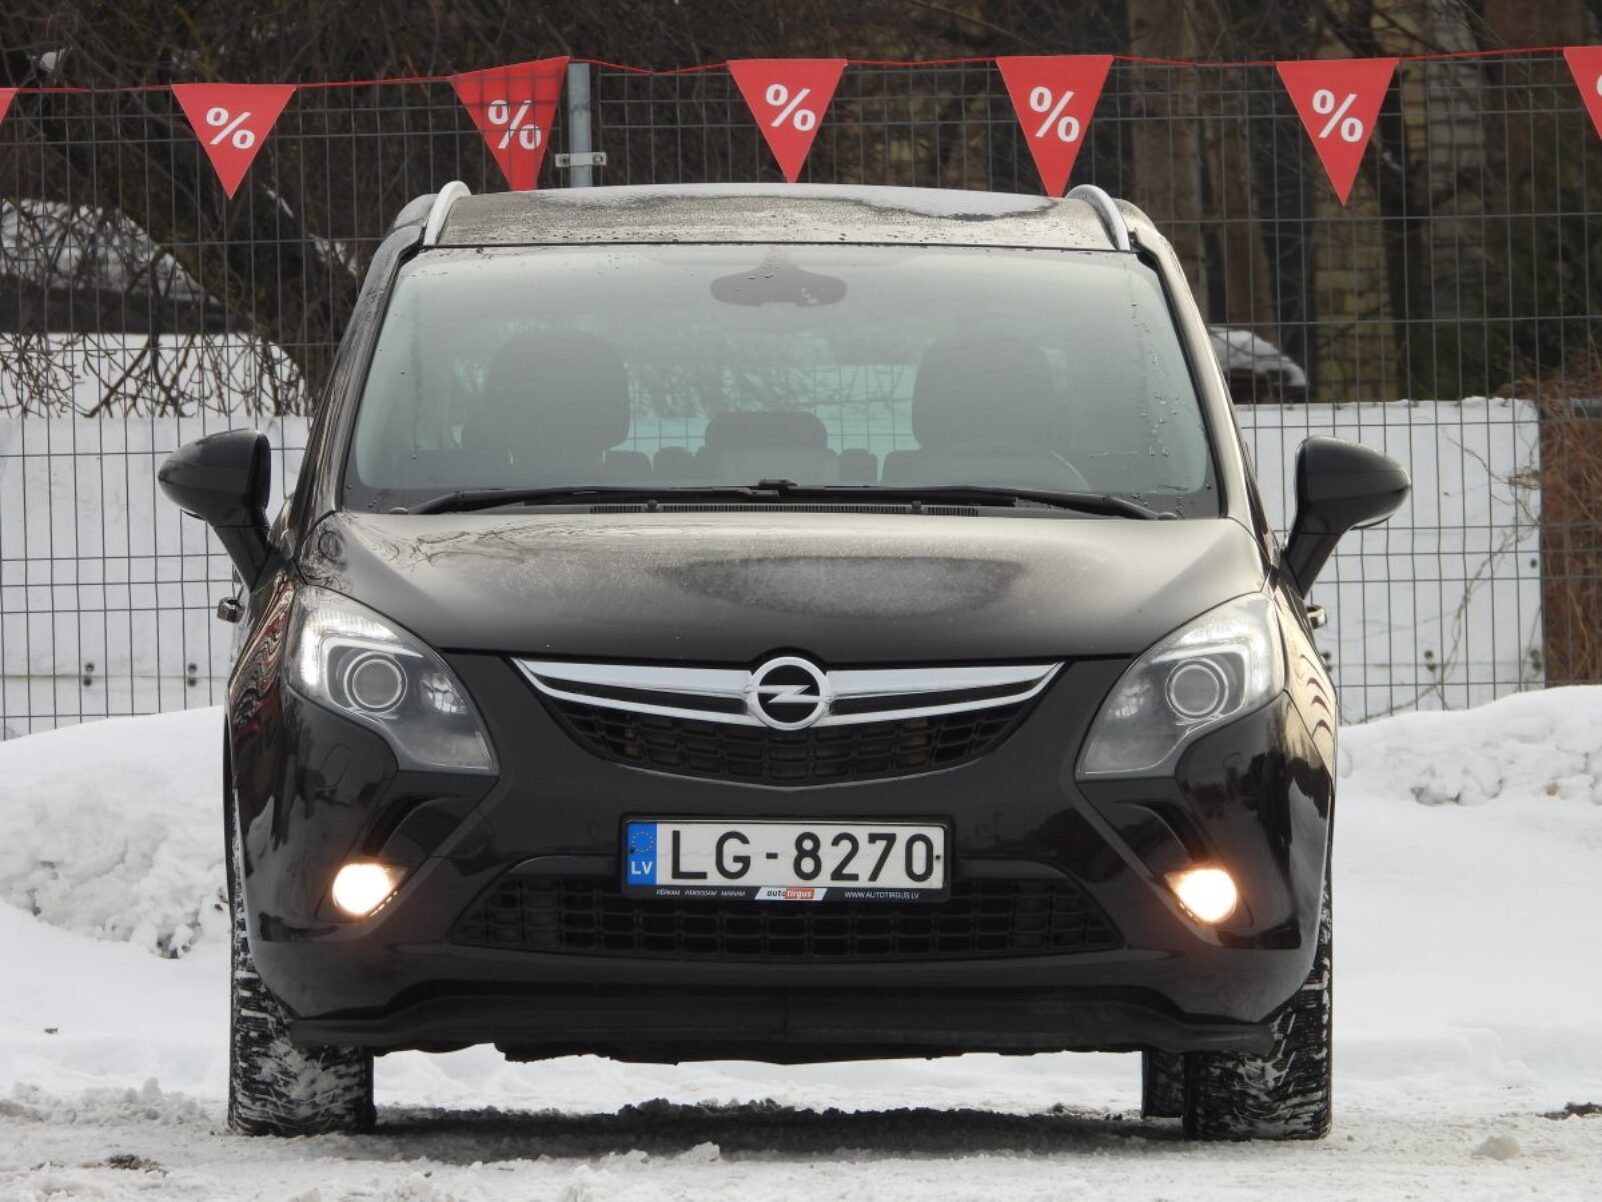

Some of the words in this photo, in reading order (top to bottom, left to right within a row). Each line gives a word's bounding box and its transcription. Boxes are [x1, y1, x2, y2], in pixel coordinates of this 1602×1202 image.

[206, 106, 256, 150] %
[488, 98, 542, 150] %
[765, 83, 816, 132] %
[1029, 86, 1080, 143] %
[1312, 89, 1364, 143] %
[630, 861, 653, 876] LV
